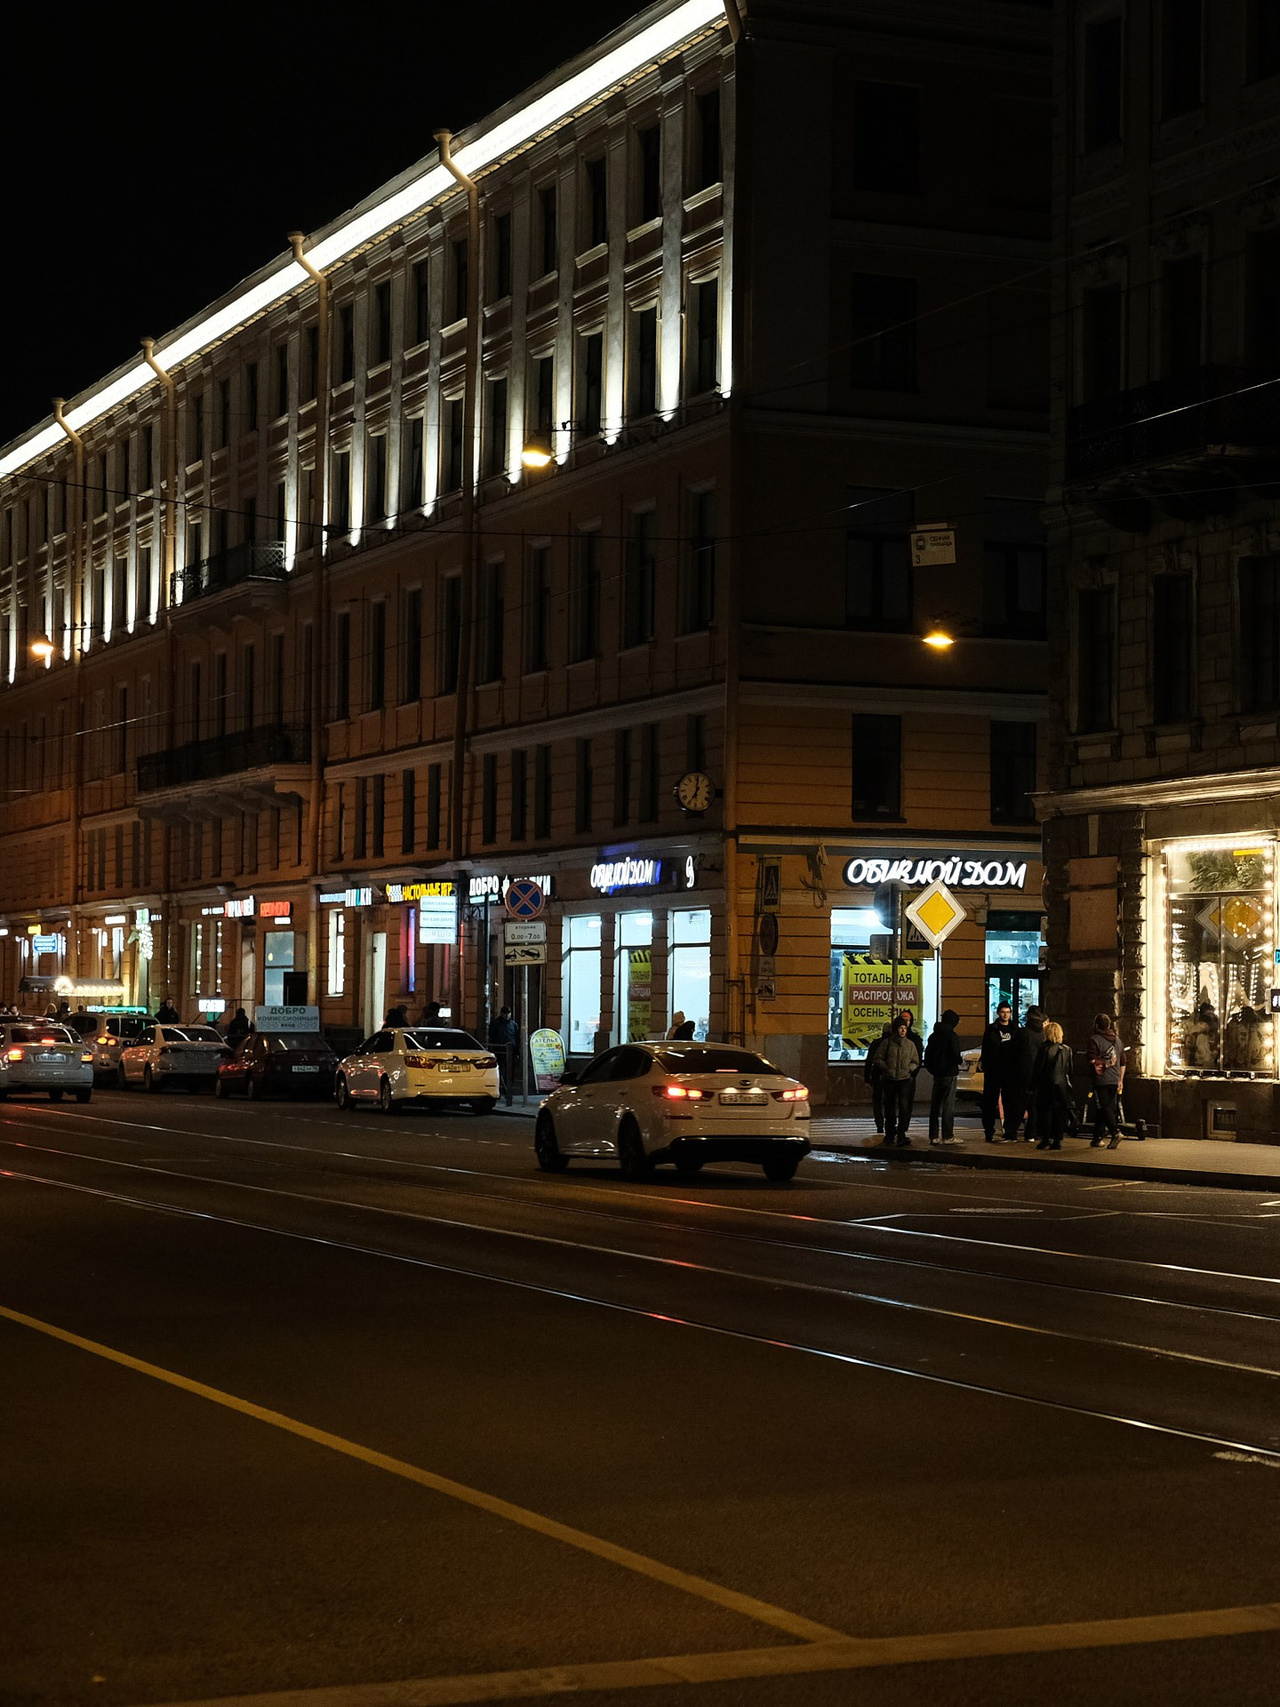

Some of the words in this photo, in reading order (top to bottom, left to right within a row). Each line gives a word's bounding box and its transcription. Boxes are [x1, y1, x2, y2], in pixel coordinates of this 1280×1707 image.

[915, 554, 921, 564] 3
[847, 856, 961, 885] ОБУВНОЙ
[961, 861, 1027, 889] ДОМ
[469, 875, 500, 896] ДОБРО
[854, 973, 912, 983] ТОТАЛЬАЯ
[270, 1007, 306, 1015] ДОБРО
